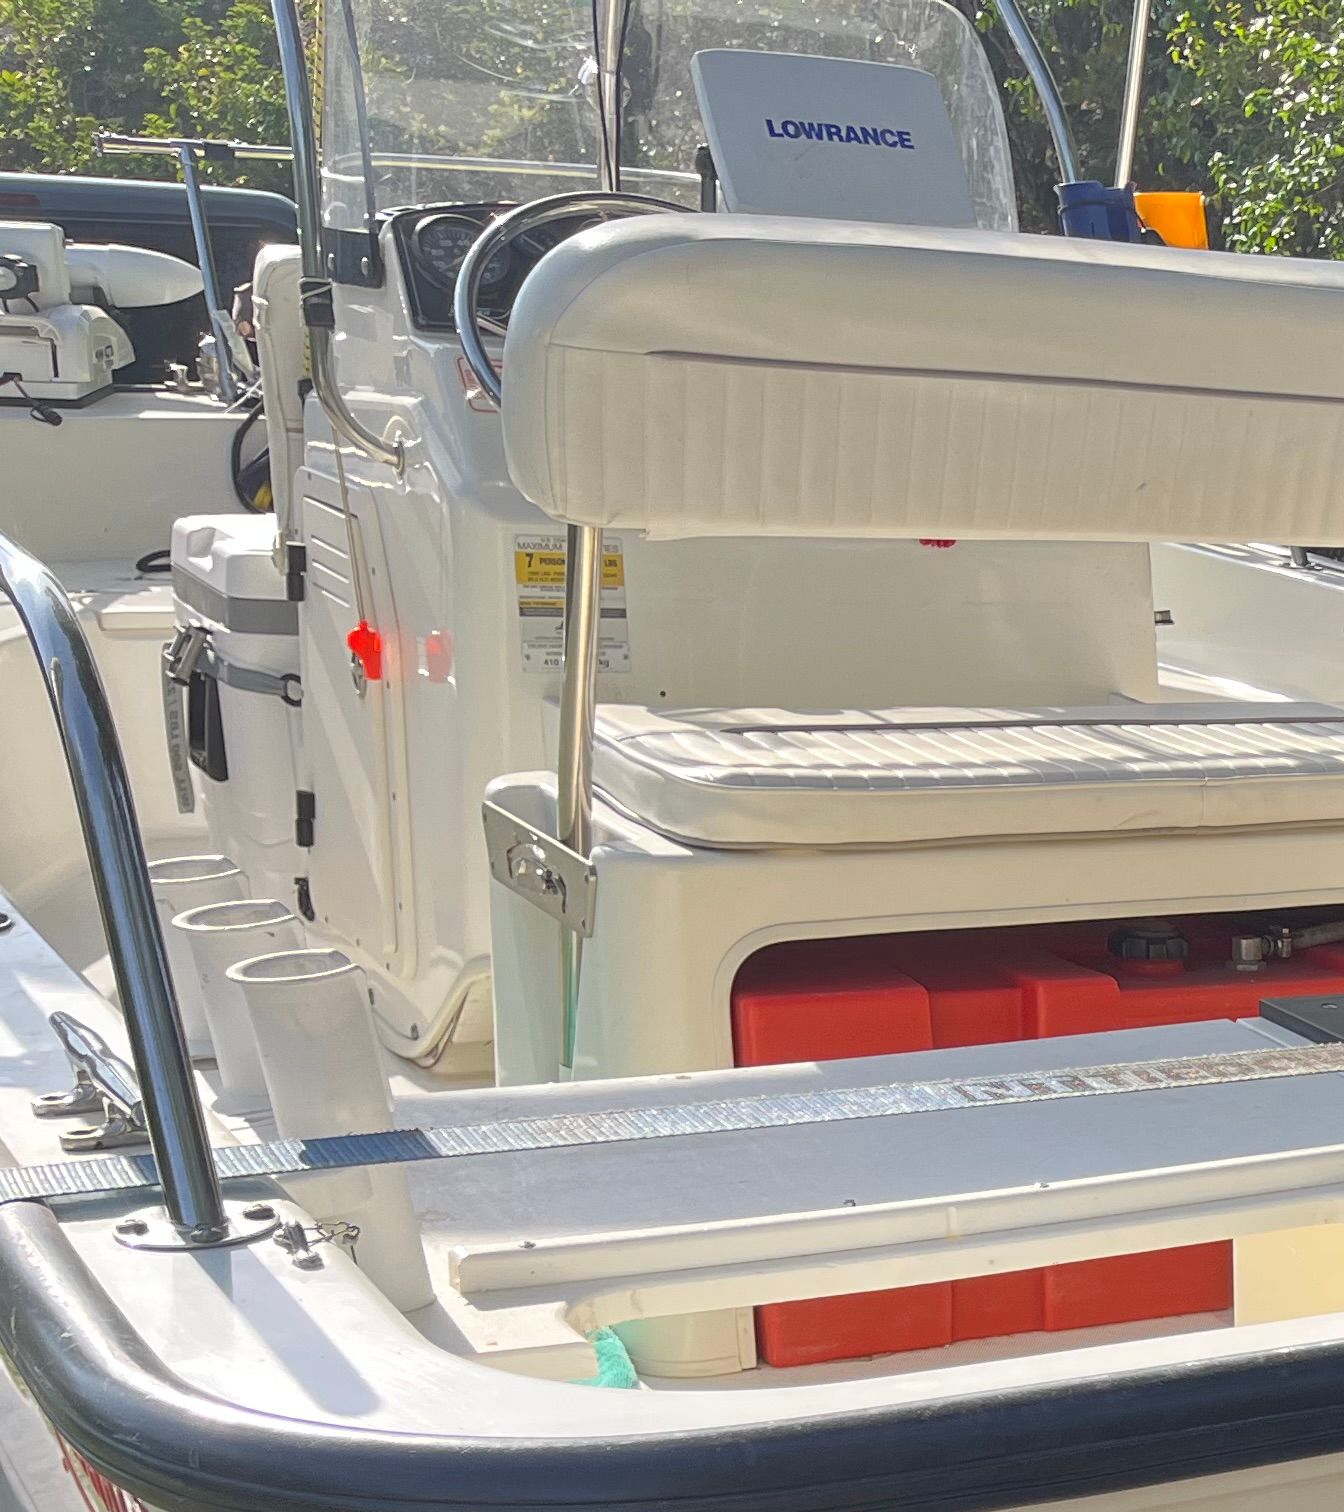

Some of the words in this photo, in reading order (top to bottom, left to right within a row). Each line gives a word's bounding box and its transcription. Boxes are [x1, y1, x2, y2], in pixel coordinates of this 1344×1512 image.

[765, 118, 915, 150] LOWRANCE
[517, 541, 563, 551] MAXIMUM
[525, 552, 534, 568] 7
[539, 557, 565, 566] PERSON
